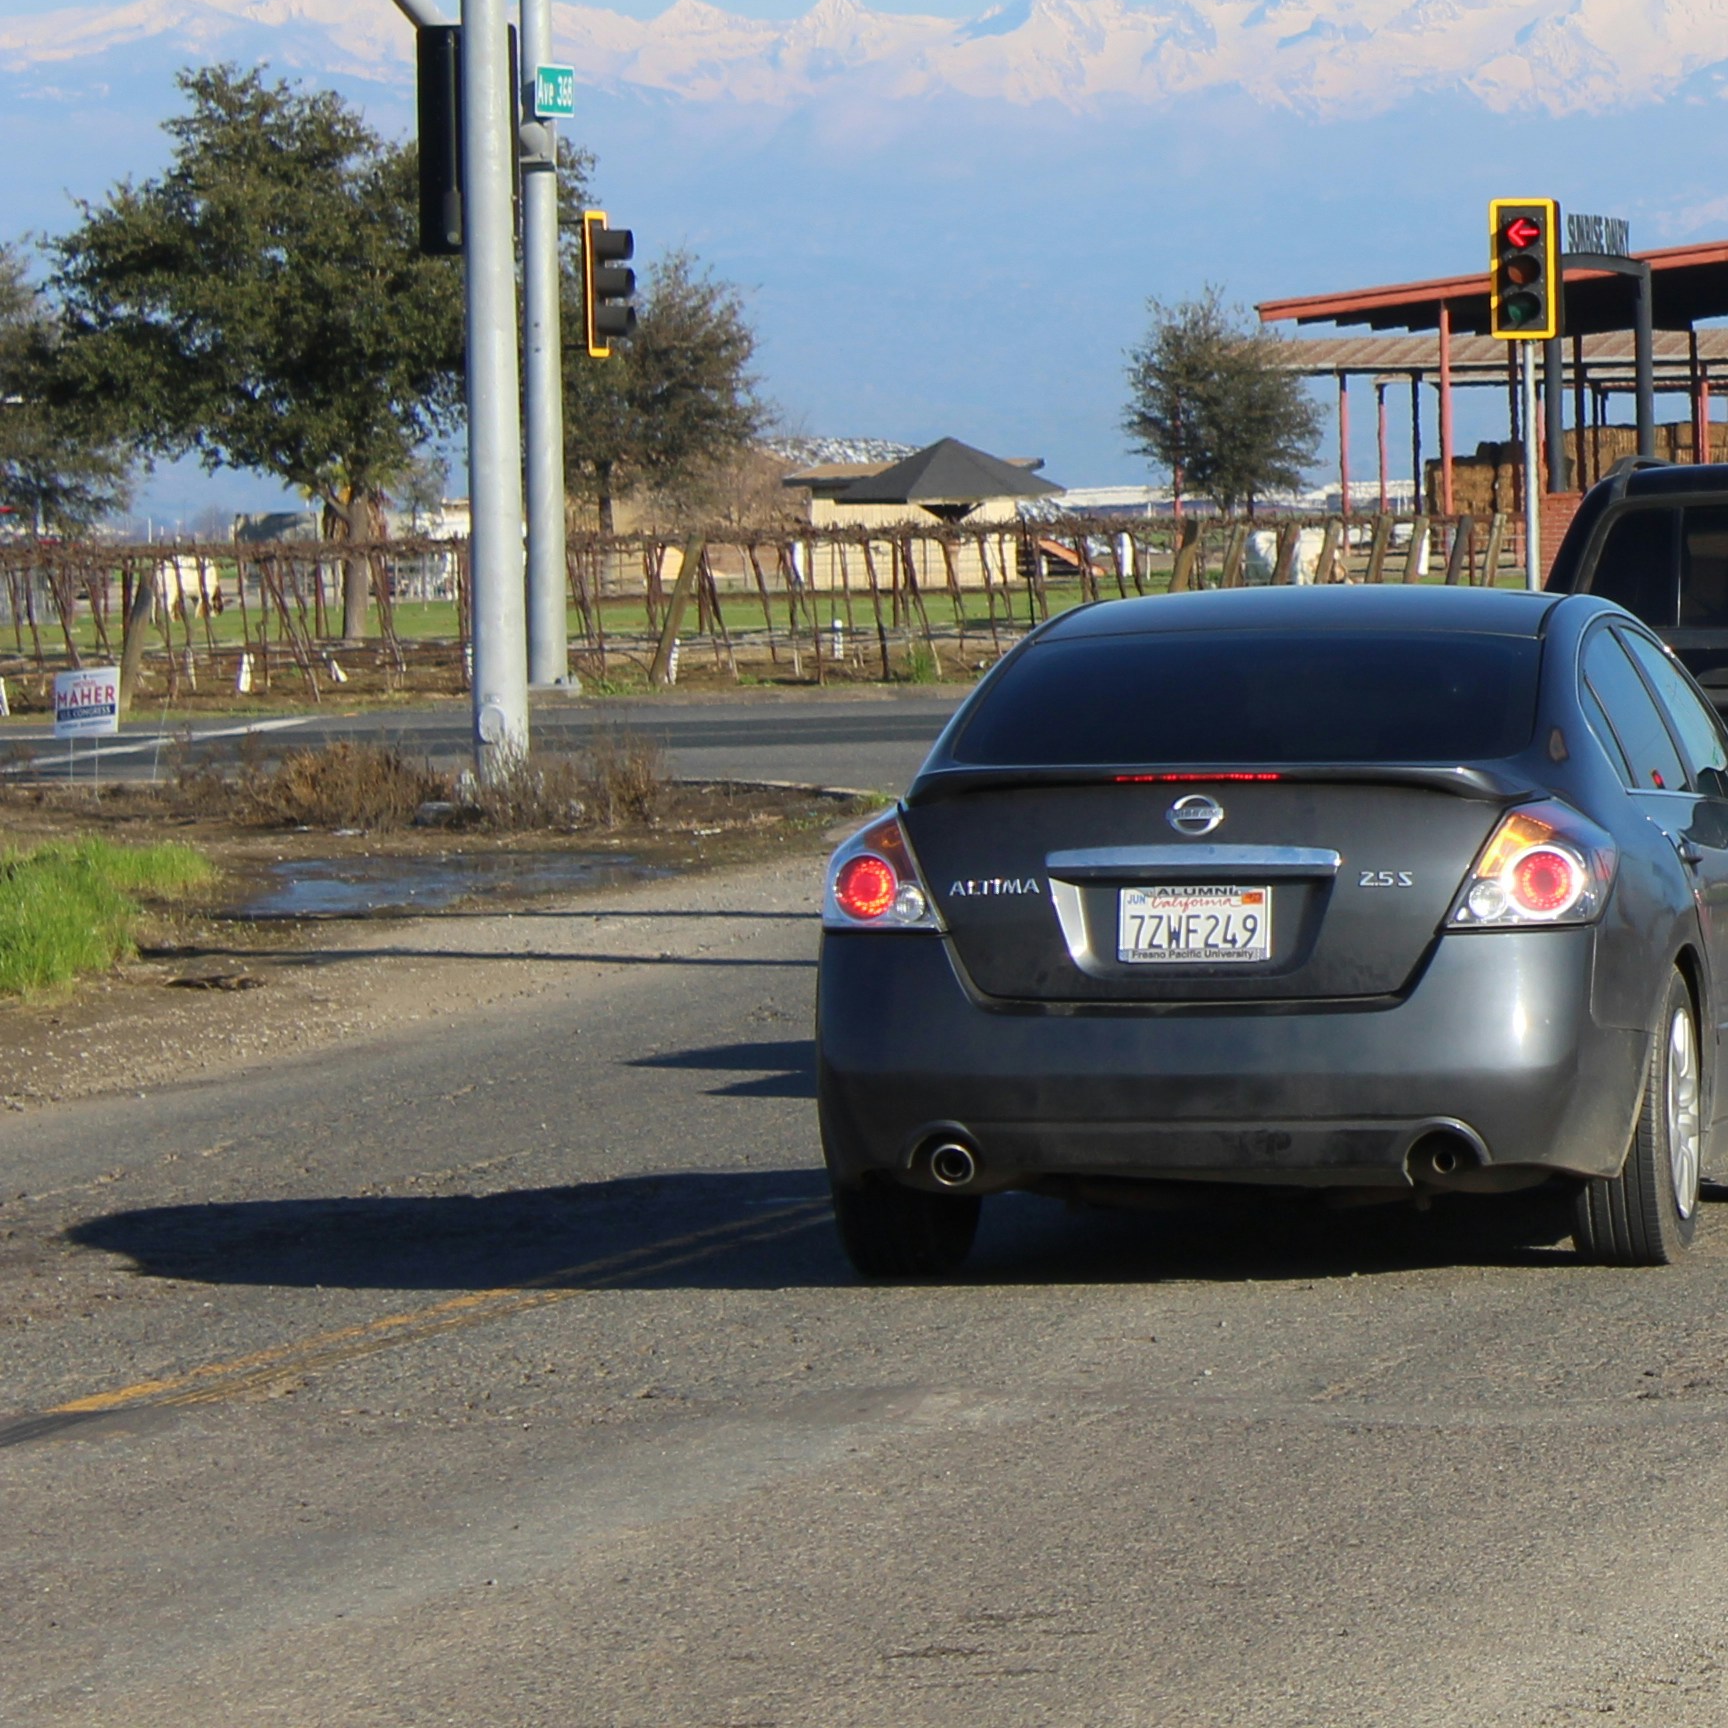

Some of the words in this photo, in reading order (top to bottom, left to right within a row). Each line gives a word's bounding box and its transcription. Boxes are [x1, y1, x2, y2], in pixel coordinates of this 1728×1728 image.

[538, 74, 554, 106] Ave
[57, 685, 115, 708] MAHER
[949, 878, 1040, 897] ALTIMA
[1397, 871, 1413, 887] S
[1127, 894, 1146, 905] JUN
[1157, 887, 1234, 896] ALUMNI
[1151, 896, 1242, 913] California
[1130, 914, 1258, 950] 7ZWF249
[1132, 949, 1165, 959] Fresno
[1169, 949, 1202, 959] Pacific
[1204, 949, 1254, 960] University
